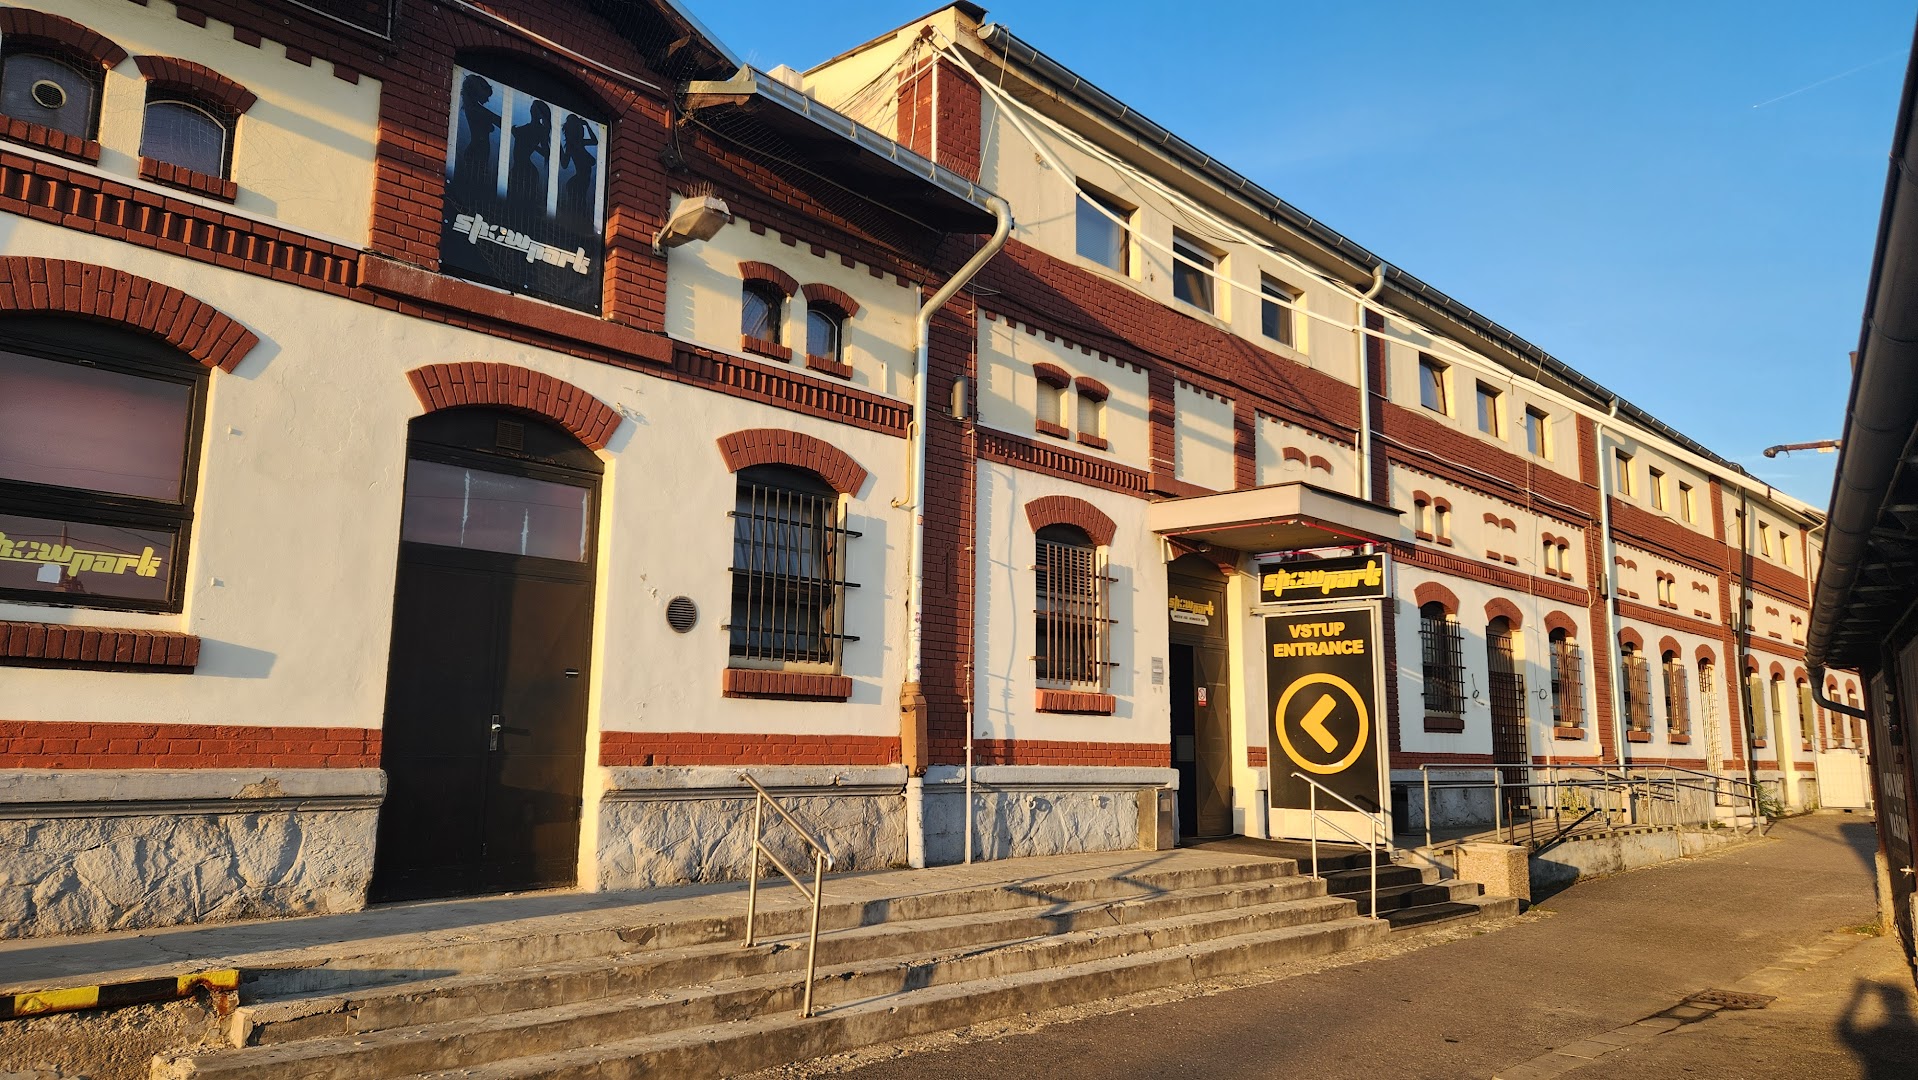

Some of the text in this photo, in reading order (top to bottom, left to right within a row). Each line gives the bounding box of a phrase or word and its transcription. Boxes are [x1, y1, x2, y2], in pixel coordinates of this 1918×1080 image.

[0, 531, 162, 578] howpark
[1289, 622, 1345, 638] VSTUP
[1273, 640, 1364, 657] ENTRANCE
